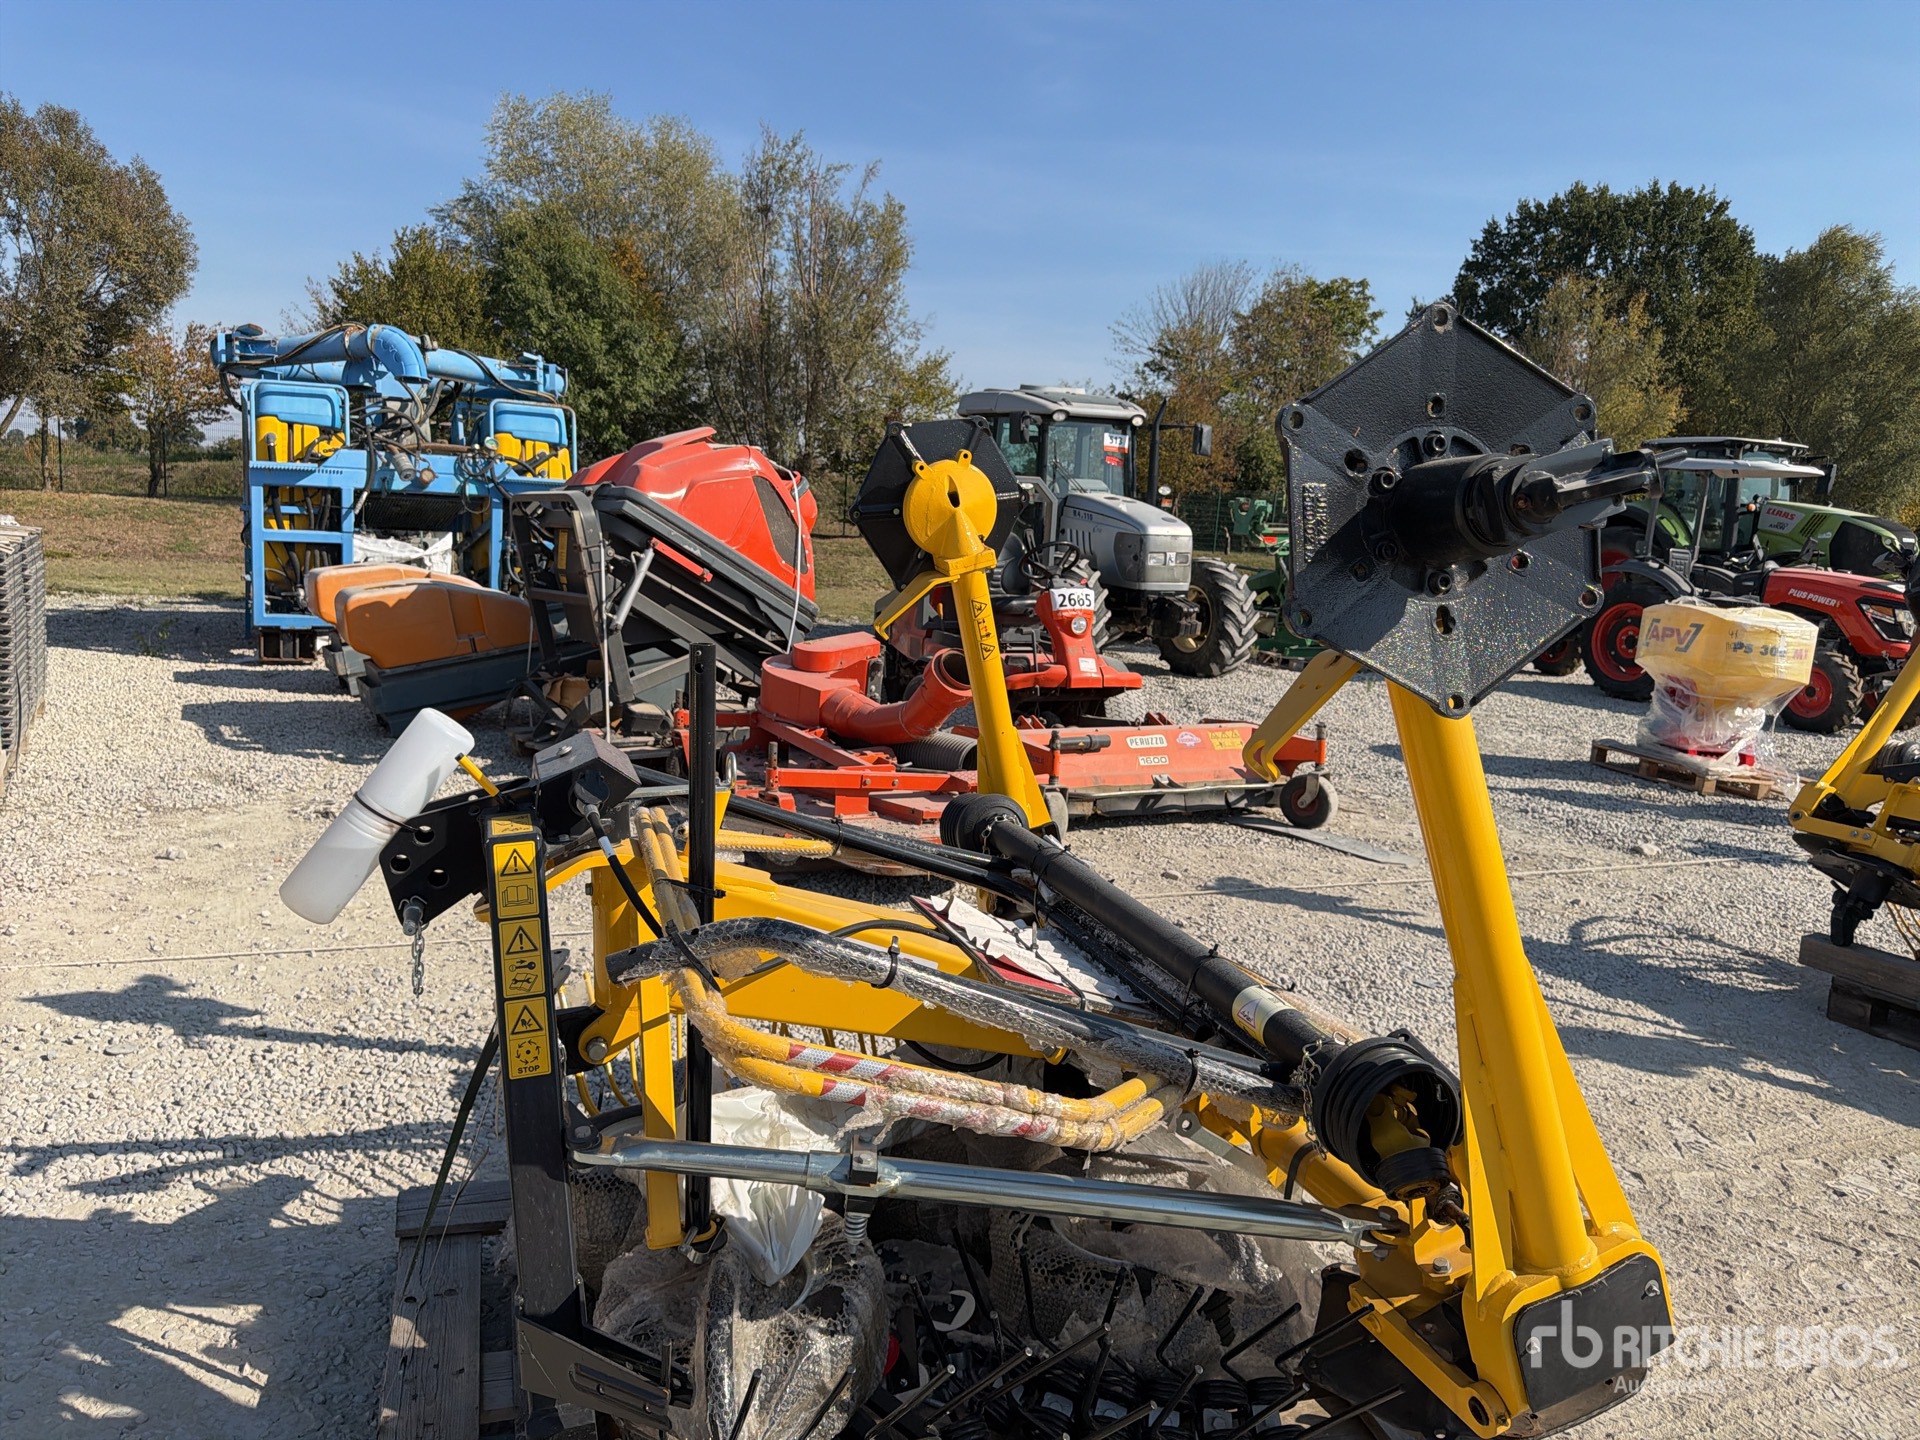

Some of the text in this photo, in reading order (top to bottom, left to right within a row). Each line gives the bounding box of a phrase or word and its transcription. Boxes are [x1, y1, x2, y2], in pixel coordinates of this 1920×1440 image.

[1766, 507, 1797, 521] CLAAS
[1057, 592, 1092, 608] 2665
[1788, 588, 1836, 606] PLUS POWER
[1129, 736, 1165, 747] PERUZZO
[1140, 755, 1168, 765] 1600
[518, 1065, 540, 1074] STOP
